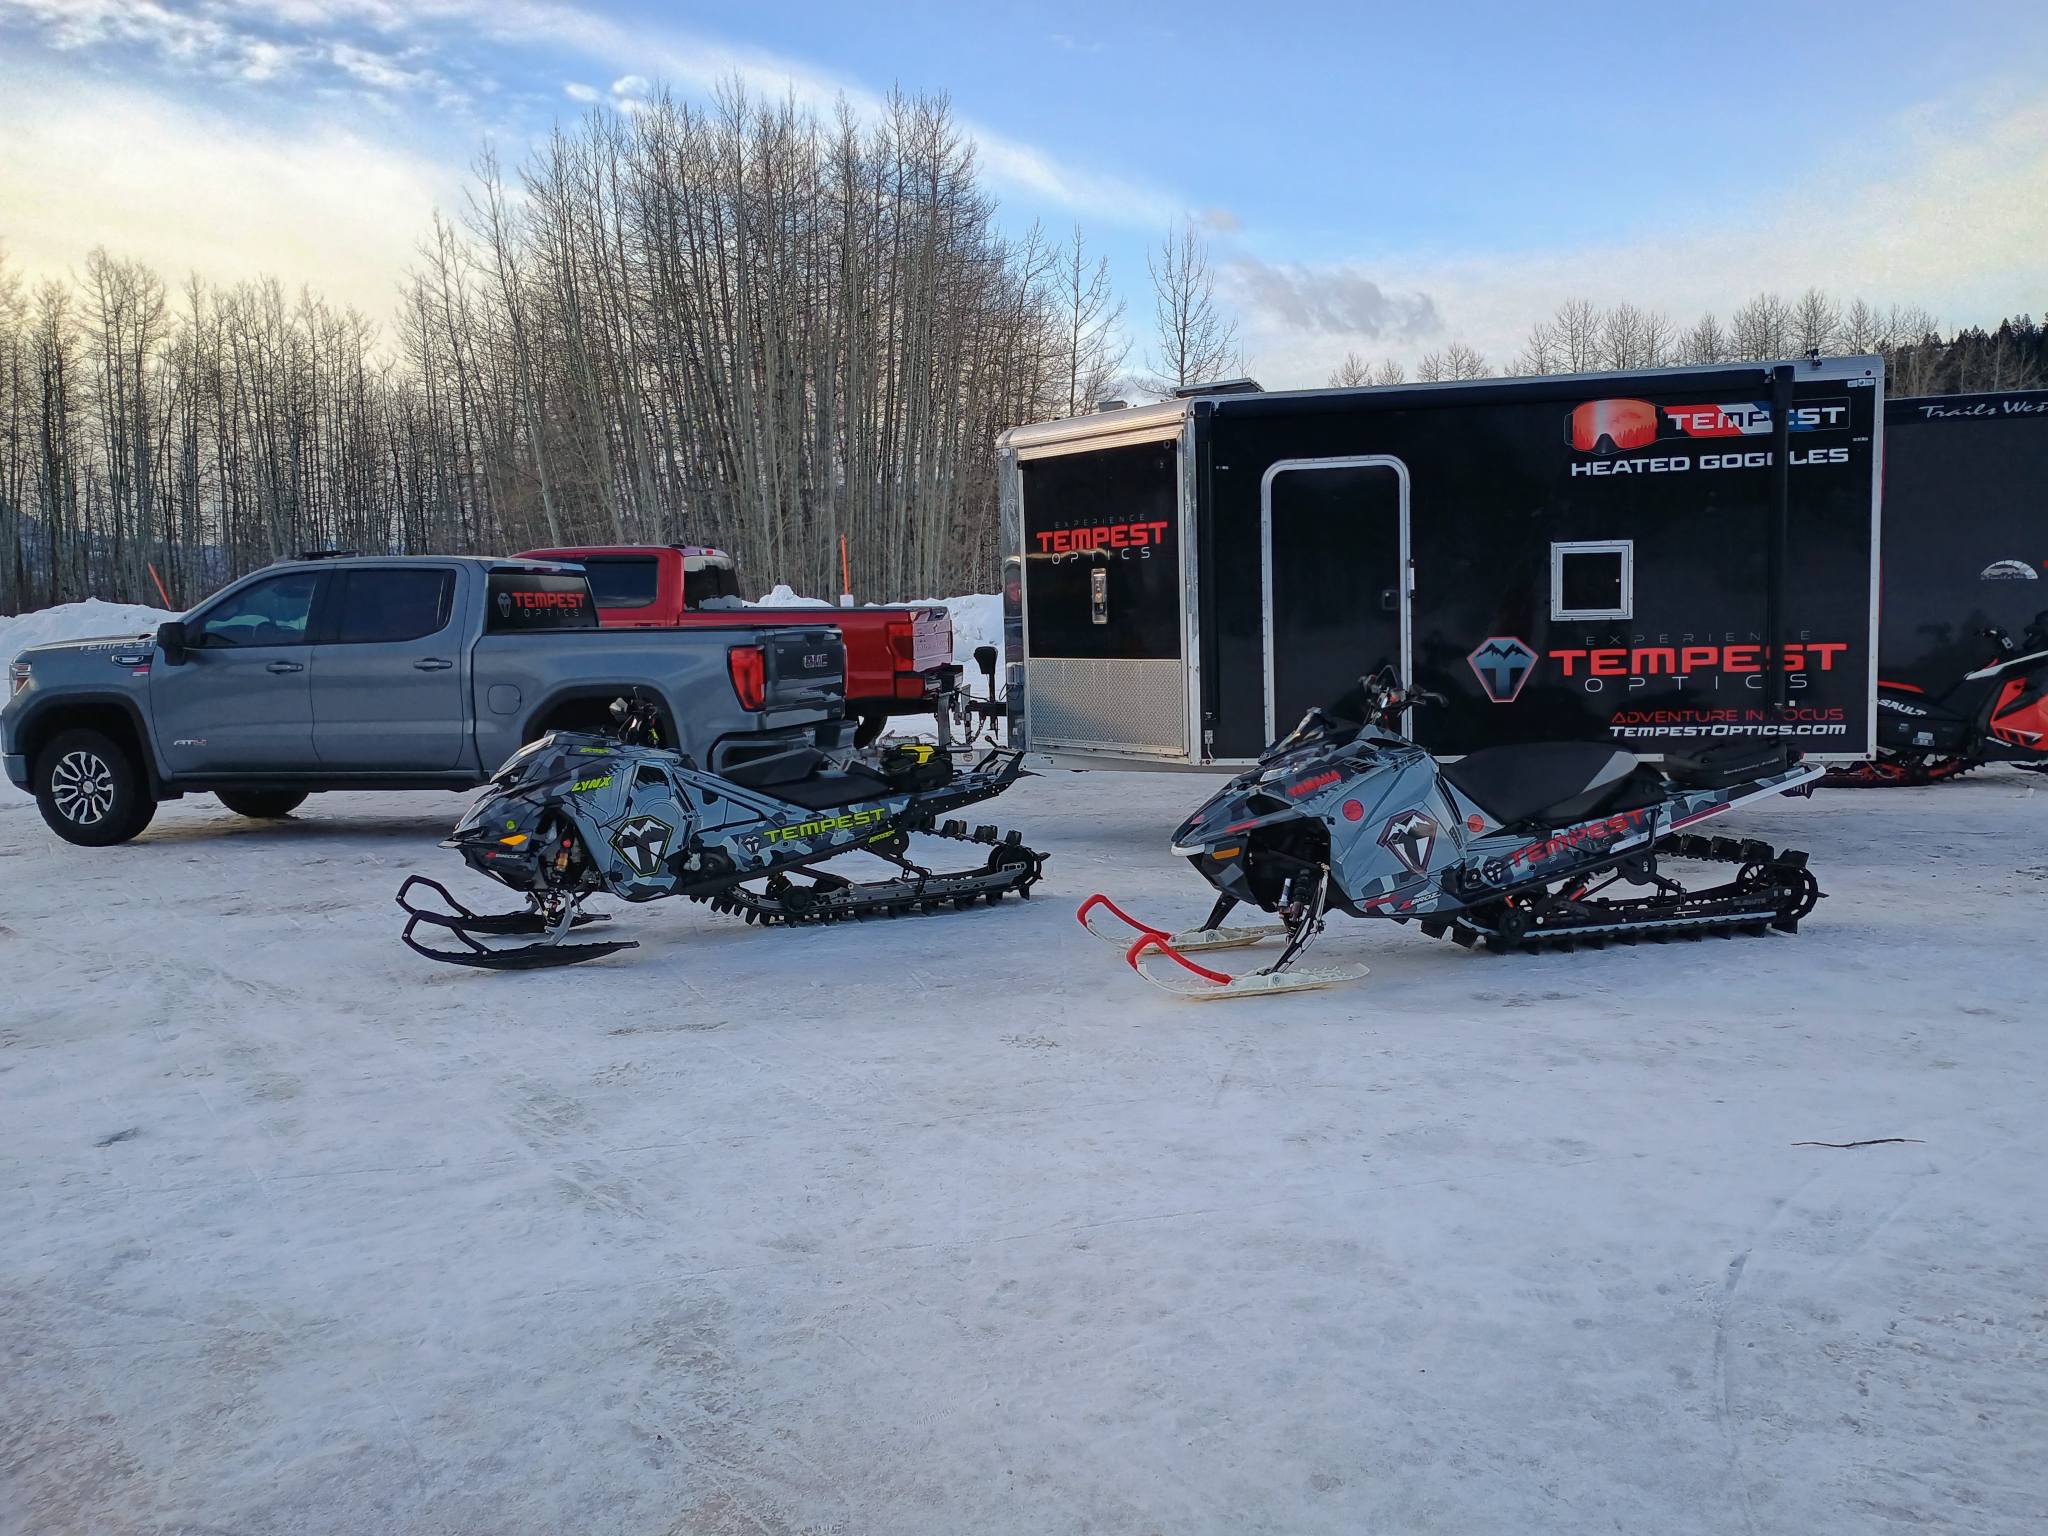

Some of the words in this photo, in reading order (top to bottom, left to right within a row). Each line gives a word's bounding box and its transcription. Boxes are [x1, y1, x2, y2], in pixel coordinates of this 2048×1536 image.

[1918, 403, 1997, 418] Trails
[1571, 456, 1691, 477] HEATED
[1054, 513, 1146, 529] EXPERIENCE
[1036, 521, 1169, 553] TEMPEST
[1051, 546, 1151, 565] OPTICS
[512, 592, 585, 608] TEMPEST
[523, 608, 580, 618] OPTICS
[1584, 630, 1811, 647] EXPERIENE
[1584, 673, 1809, 693] OPTICS
[1611, 709, 1738, 724] ADVENTURE
[1746, 709, 1765, 722] IN
[1782, 707, 1845, 722] OCUS
[1877, 699, 1928, 716] SAULT
[571, 776, 612, 792] LYNX
[763, 807, 886, 843] TEMPEST
[1508, 808, 1645, 868] TEMPEST
